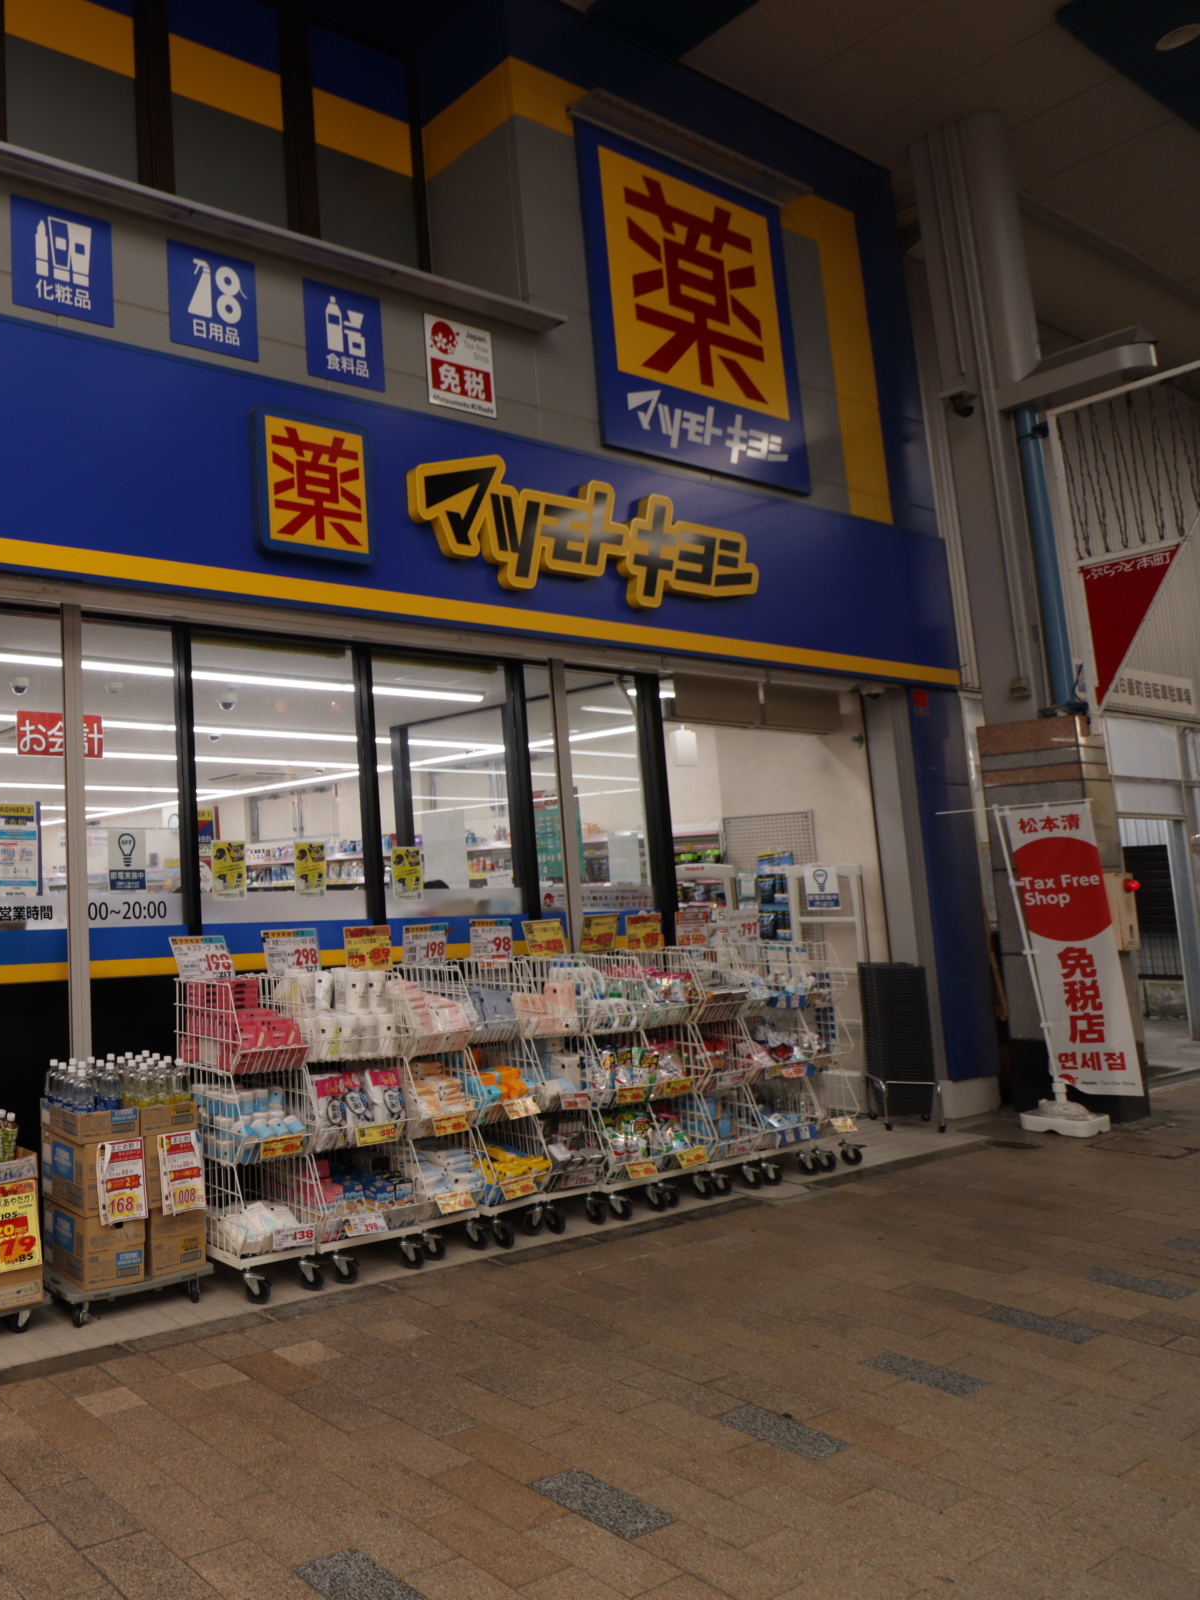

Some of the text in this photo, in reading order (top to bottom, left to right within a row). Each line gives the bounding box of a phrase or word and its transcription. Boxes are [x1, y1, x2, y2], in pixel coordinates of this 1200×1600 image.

[35, 279, 92, 311] 化粧品
[622, 174, 770, 405] 薬
[192, 318, 241, 347] 日用品
[463, 340, 489, 354] Tax-free
[326, 352, 370, 379] 食料品
[473, 352, 490, 364] Shop
[438, 363, 486, 400] 免税
[432, 393, 494, 415] Matsumoto KiYoshi
[626, 388, 790, 465] マツモトキヨシ
[270, 425, 364, 548] 薬
[409, 456, 758, 606] マツモトキヨシ
[1017, 813, 1081, 835] 松本清
[110, 871, 145, 880] 節電実施中
[1023, 873, 1101, 890] Tax Free
[1024, 890, 1071, 908] Shop
[371, 947, 391, 960] 89
[425, 941, 446, 959] 198
[493, 936, 512, 952] 98
[205, 953, 232, 972] 198
[294, 947, 319, 967] 298
[1056, 946, 1106, 1045] 免税店
[1058, 1051, 1127, 1071] 면세점
[1, 1187, 18, 1198] Sale
[110, 1196, 135, 1216] 168
[293, 1229, 314, 1241] 138
[364, 1223, 379, 1232] 298
[0, 1235, 37, 1257] 79
[119, 1252, 139, 1261] STRONG
